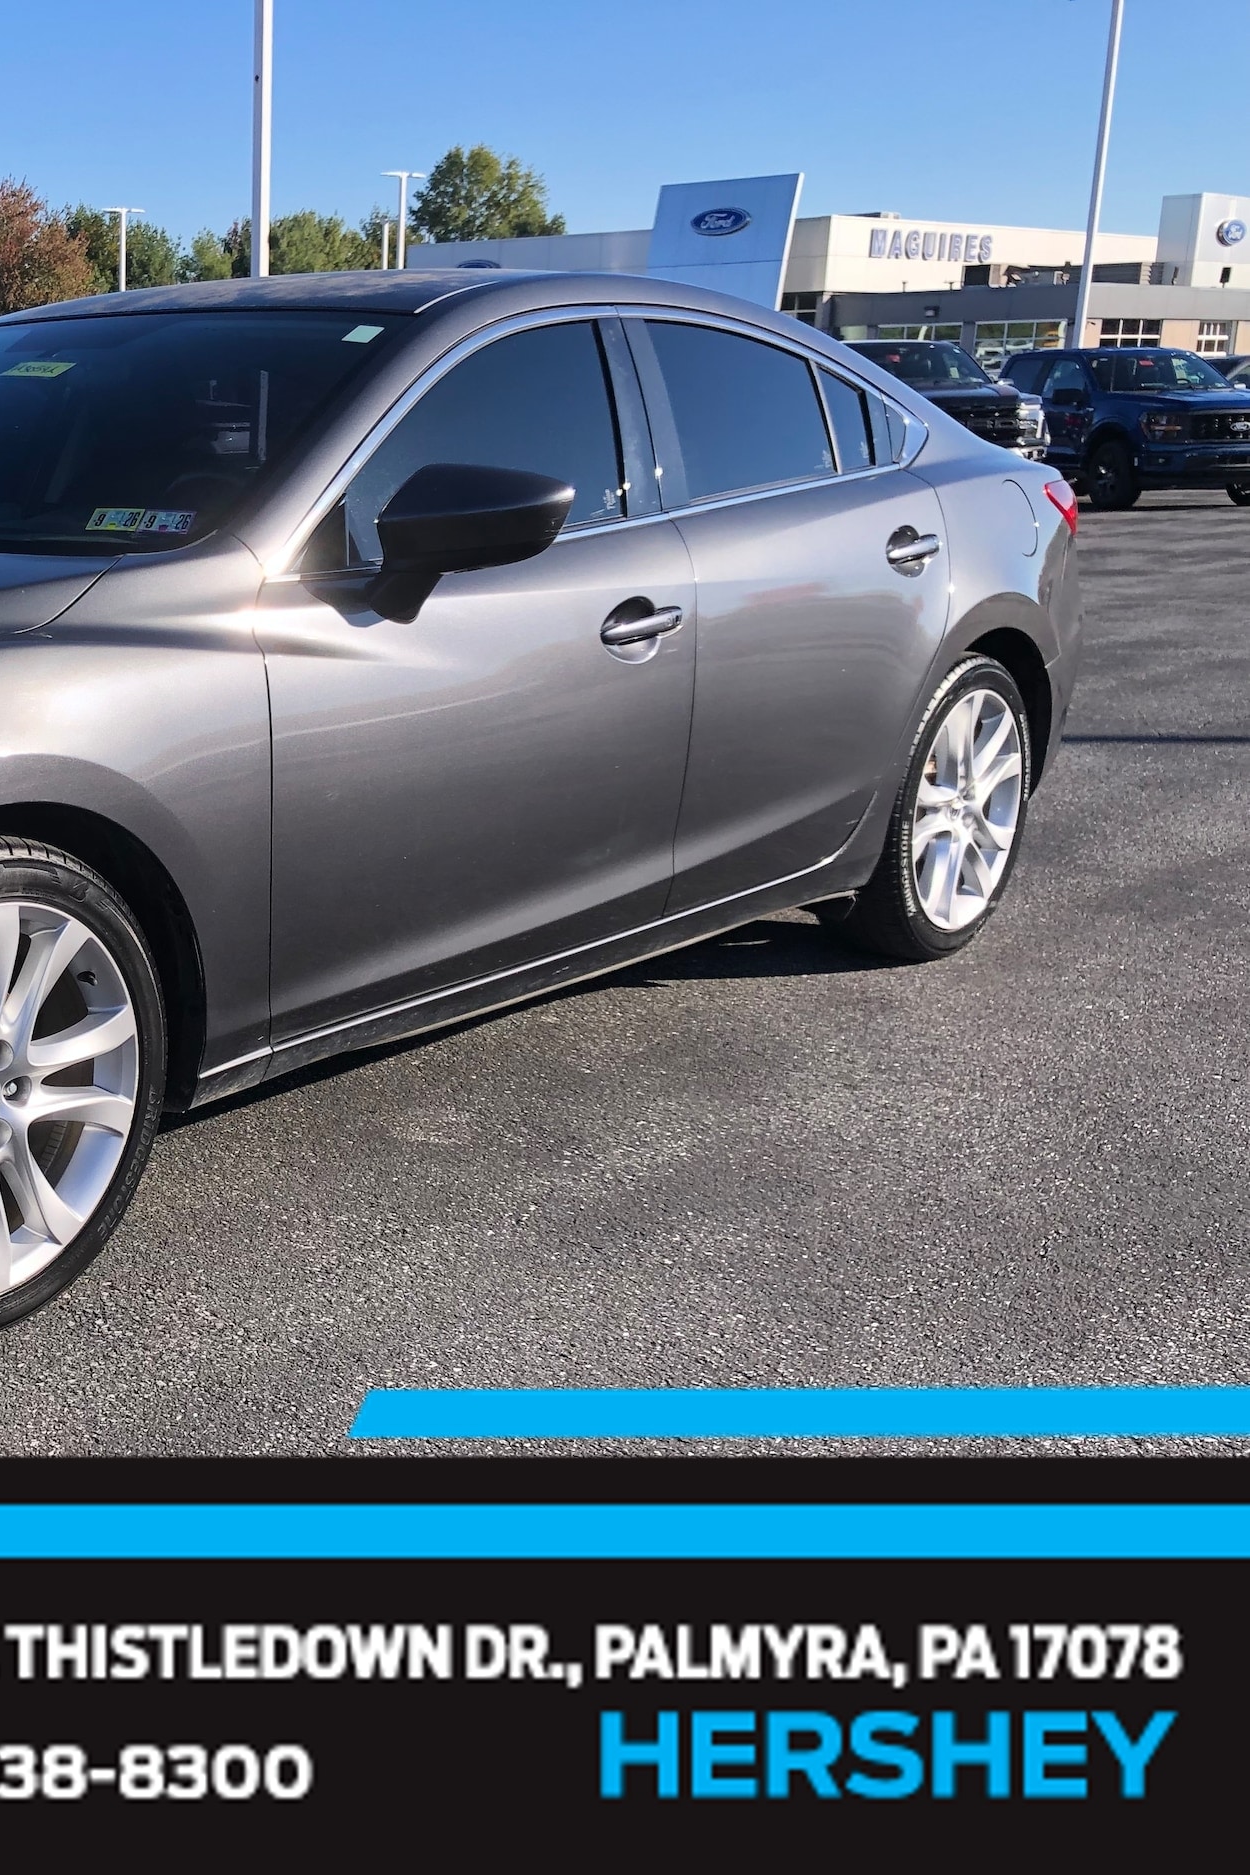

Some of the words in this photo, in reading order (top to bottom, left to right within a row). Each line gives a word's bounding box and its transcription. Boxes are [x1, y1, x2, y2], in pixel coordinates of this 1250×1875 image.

[868, 228, 993, 263] MAGUIRES
[123, 511, 141, 527] 26
[175, 514, 192, 530] 26
[97, 1084, 162, 1241] BRIDGESTONE
